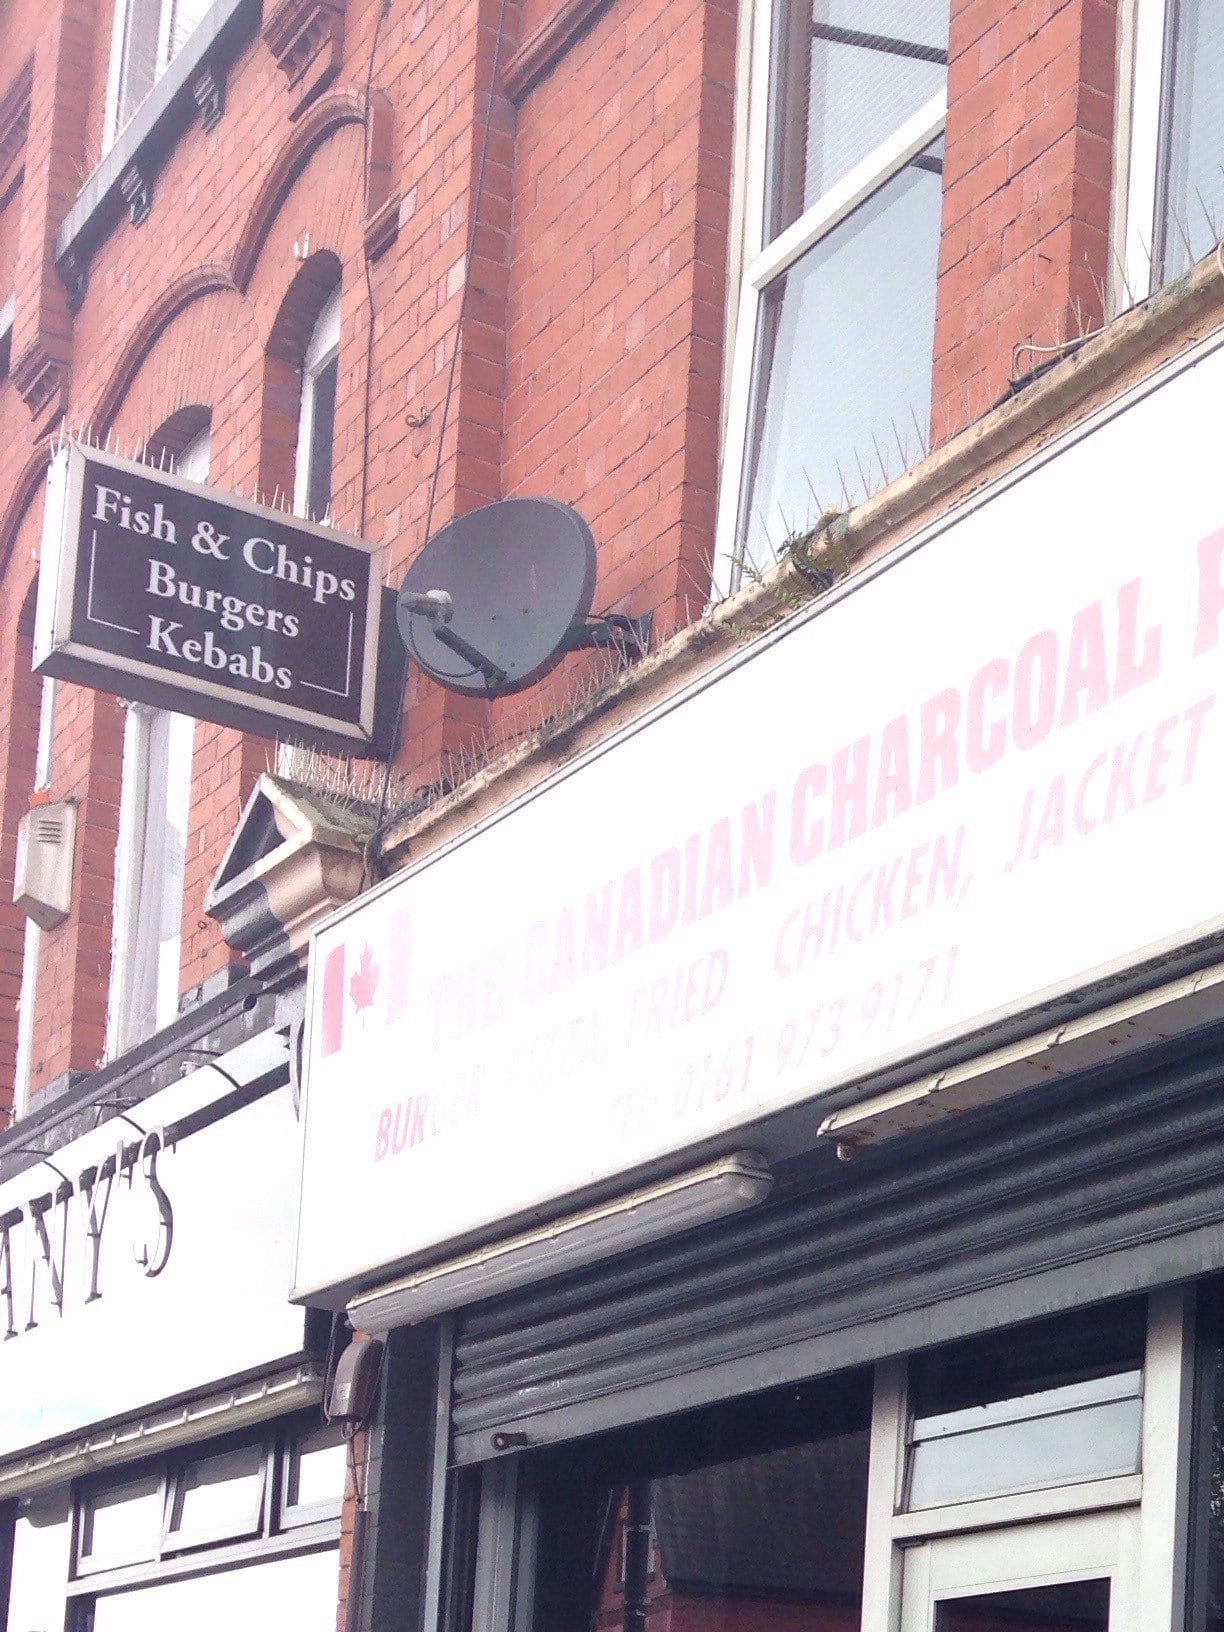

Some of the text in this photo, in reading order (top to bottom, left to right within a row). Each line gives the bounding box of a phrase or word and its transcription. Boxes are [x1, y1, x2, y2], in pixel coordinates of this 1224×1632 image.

[92, 484, 356, 604] Fish & Chips
[147, 559, 300, 638] Burgers
[147, 616, 293, 691] Kebabs
[521, 791, 778, 1007] CANADIAN
[789, 575, 1161, 866] CHARCOAL
[626, 947, 730, 1050] FRIED
[775, 824, 973, 976] CHICKEN,
[1004, 694, 1216, 873] JACKET
[774, 997, 848, 1077] 973
[860, 945, 960, 1036] 9171
